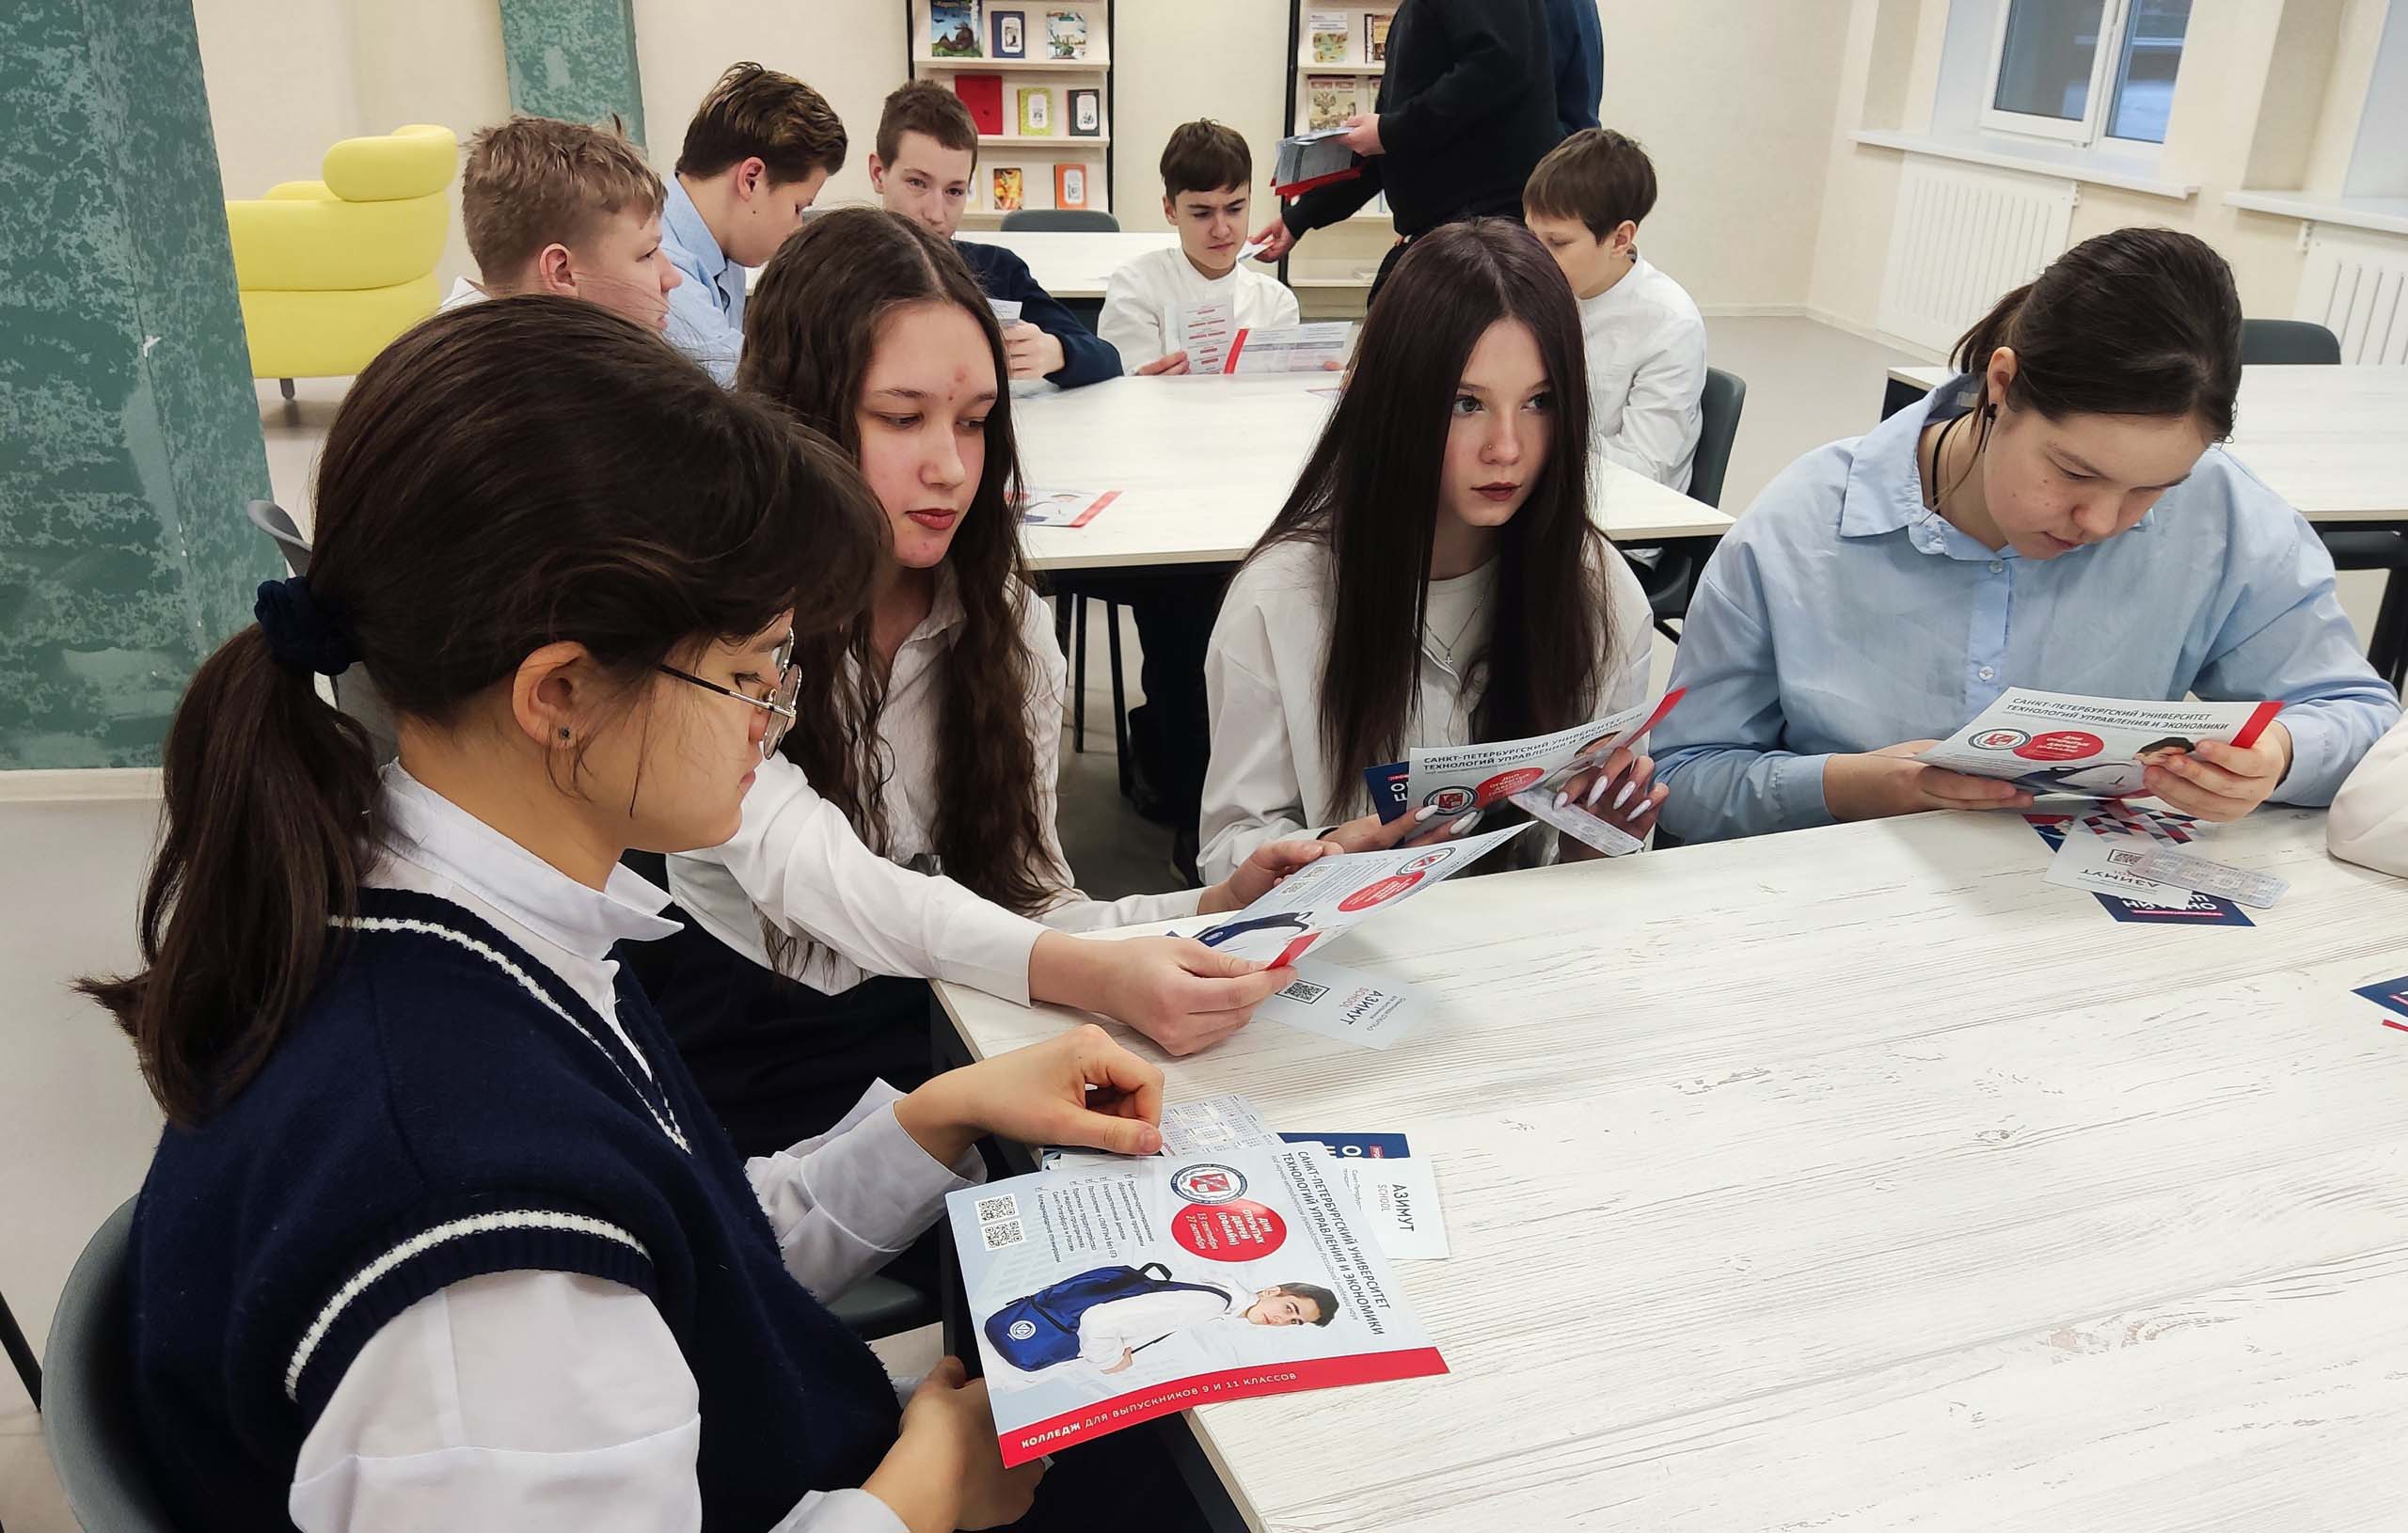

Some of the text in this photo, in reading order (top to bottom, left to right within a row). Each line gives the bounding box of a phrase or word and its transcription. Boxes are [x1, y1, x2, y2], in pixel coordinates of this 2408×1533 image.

[2006, 704, 2080, 719] ТЕХНОЛОГИЙ
[2079, 713, 2151, 728] УПРАВЛЕНИЯ
[2162, 721, 2230, 731] ЭКОНОМИКИ
[2013, 698, 2212, 721] САНКТ-ПЕТЕРБУРГСКИЙ УНИВЕРСИТЕТ
[1423, 756, 1495, 770] ТЕХНОЛОГИЙ
[1497, 741, 1566, 763] УПРАВЛЕНИЯ
[1424, 739, 1549, 764] САНКТ-ПЕТЕРБУРГСКИЙ
[2079, 868, 2161, 888] АЗИМУТ
[2122, 898, 2218, 910] ОНЙН
[1339, 987, 1370, 1008] SCHOOL
[1339, 989, 1385, 1025] АЗИМУТ
[1377, 1183, 1391, 1212] SCHOOL
[1392, 1183, 1415, 1232] АЗИМУТ
[1190, 1223, 1206, 1250] октября
[1202, 1220, 1219, 1250] сентября
[1216, 1212, 1240, 1246] (ОФЛАЙН)
[1230, 1215, 1251, 1240] ДВЕРЕЙ
[1243, 1209, 1265, 1244] ОТКРЫТЫХ
[1257, 1217, 1273, 1233] ДНИ
[1298, 1151, 1391, 1309] САНКТ-ПЕТЕРБУРГСКИЙ УНИВЕРСИТЕТ
[1281, 1153, 1320, 1205] ТЕХНОЛОГИЙ
[1309, 1207, 1347, 1262] УПРАВЛЕНИЯ
[1343, 1273, 1386, 1335] ЭКОНОМИКИ
[1022, 1372, 1297, 1449] КОЛЛЕДЖ ДЛЯ ВЫПУСКНИКОВ 9 И 11 КЛАССОВ
